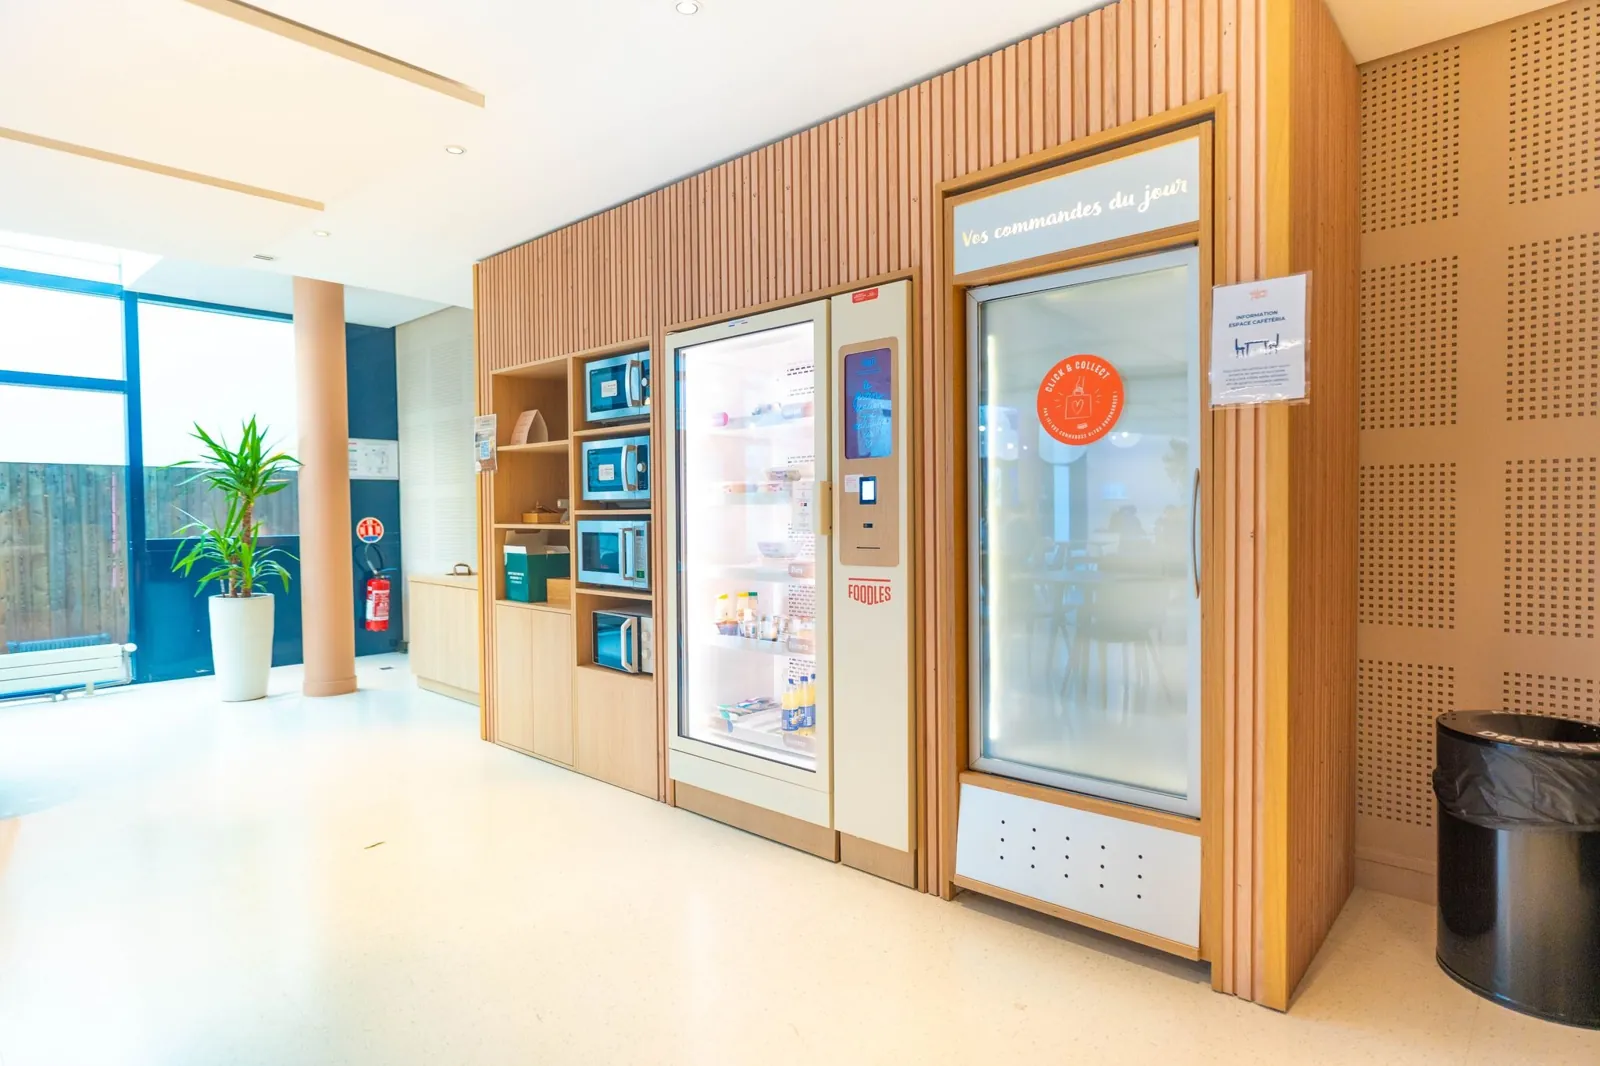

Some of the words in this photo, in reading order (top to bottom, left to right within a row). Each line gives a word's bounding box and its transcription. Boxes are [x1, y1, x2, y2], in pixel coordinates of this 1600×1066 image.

[962, 230, 988, 247] Vos
[994, 202, 1102, 239] commandes
[1108, 191, 1135, 210] du
[1137, 178, 1188, 213] jour
[1228, 320, 1251, 328] ESPACE
[1236, 310, 1278, 320] INFORMATION
[1045, 369, 1065, 393] CLICK
[1066, 363, 1073, 373] &
[1075, 360, 1110, 379] COLLECT
[848, 584, 891, 605] FOODLES
[1476, 730, 1600, 751] DECHET
